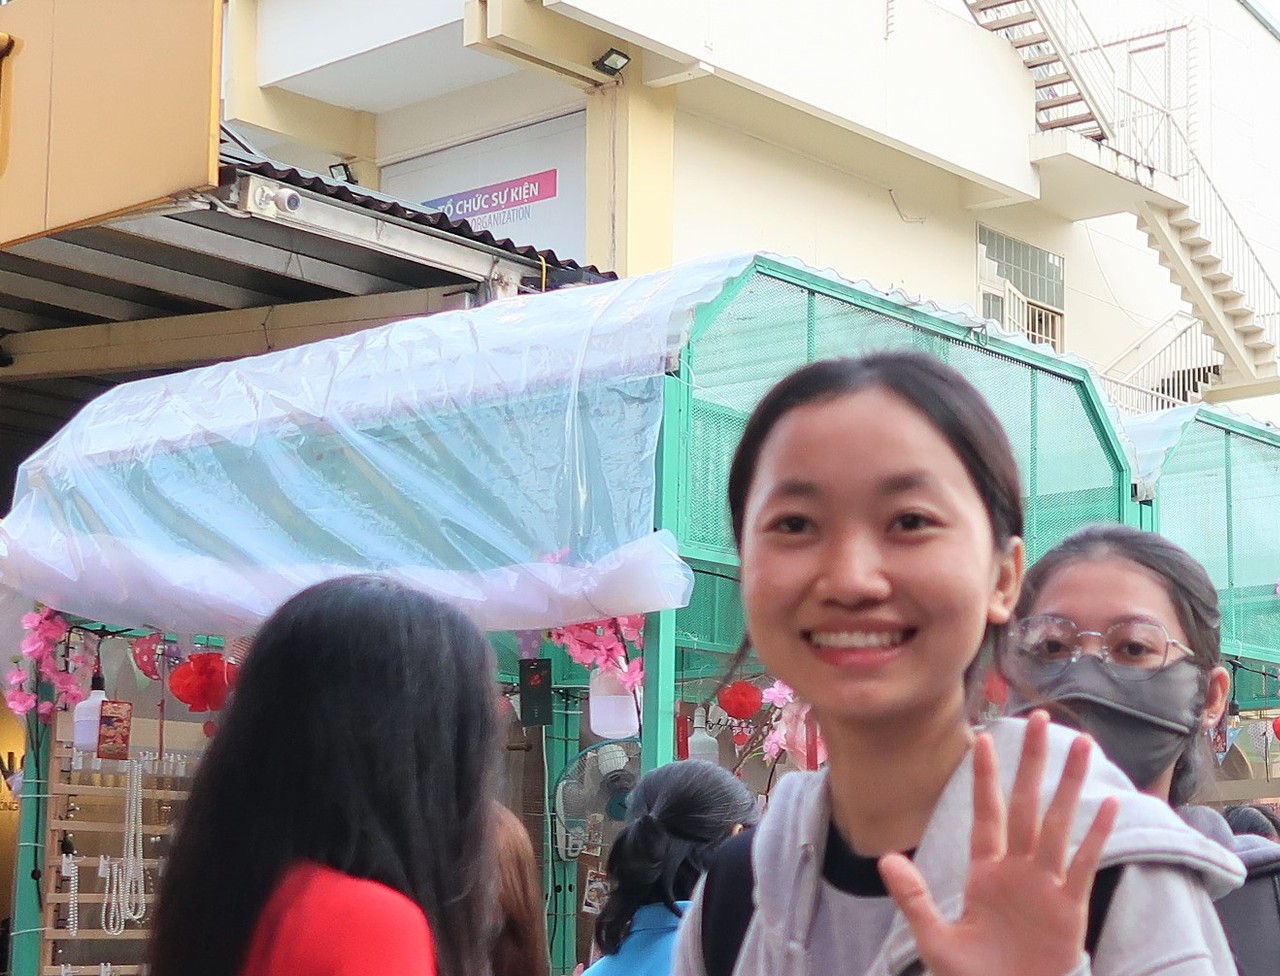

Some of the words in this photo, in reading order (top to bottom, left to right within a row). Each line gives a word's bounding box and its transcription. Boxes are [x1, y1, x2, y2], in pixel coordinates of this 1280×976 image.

[437, 198, 454, 217] TỔ
[455, 193, 489, 215] CHỨC
[491, 187, 509, 208] SỰ
[510, 182, 539, 203] KIỆN
[470, 205, 532, 231] ORGANIZATION
